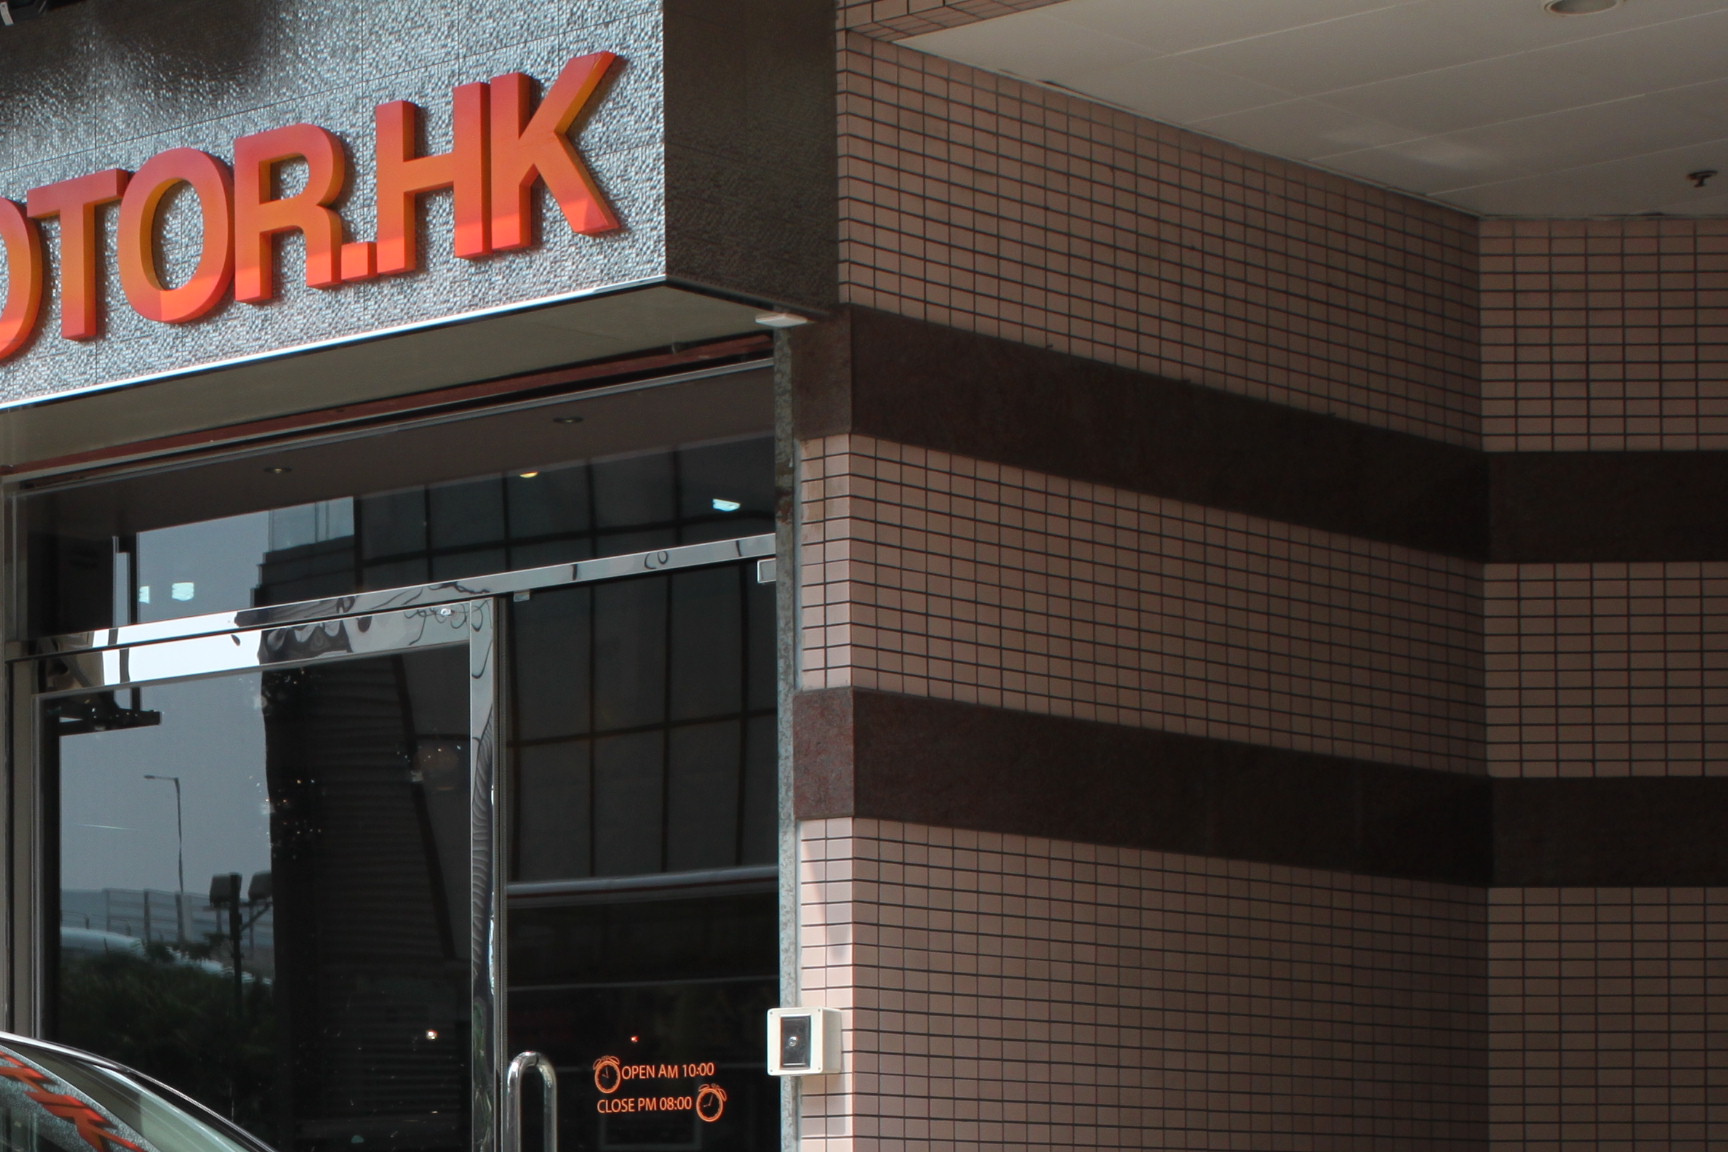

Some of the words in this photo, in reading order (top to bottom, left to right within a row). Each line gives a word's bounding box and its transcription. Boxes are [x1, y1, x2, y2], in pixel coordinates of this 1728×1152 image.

[621, 1065, 655, 1080] OPEN
[658, 1063, 679, 1078] AM
[682, 1062, 715, 1077] 10:00
[596, 1098, 635, 1113] CLOSE
[637, 1097, 657, 1111] PM
[659, 1096, 692, 1111] 08:00
